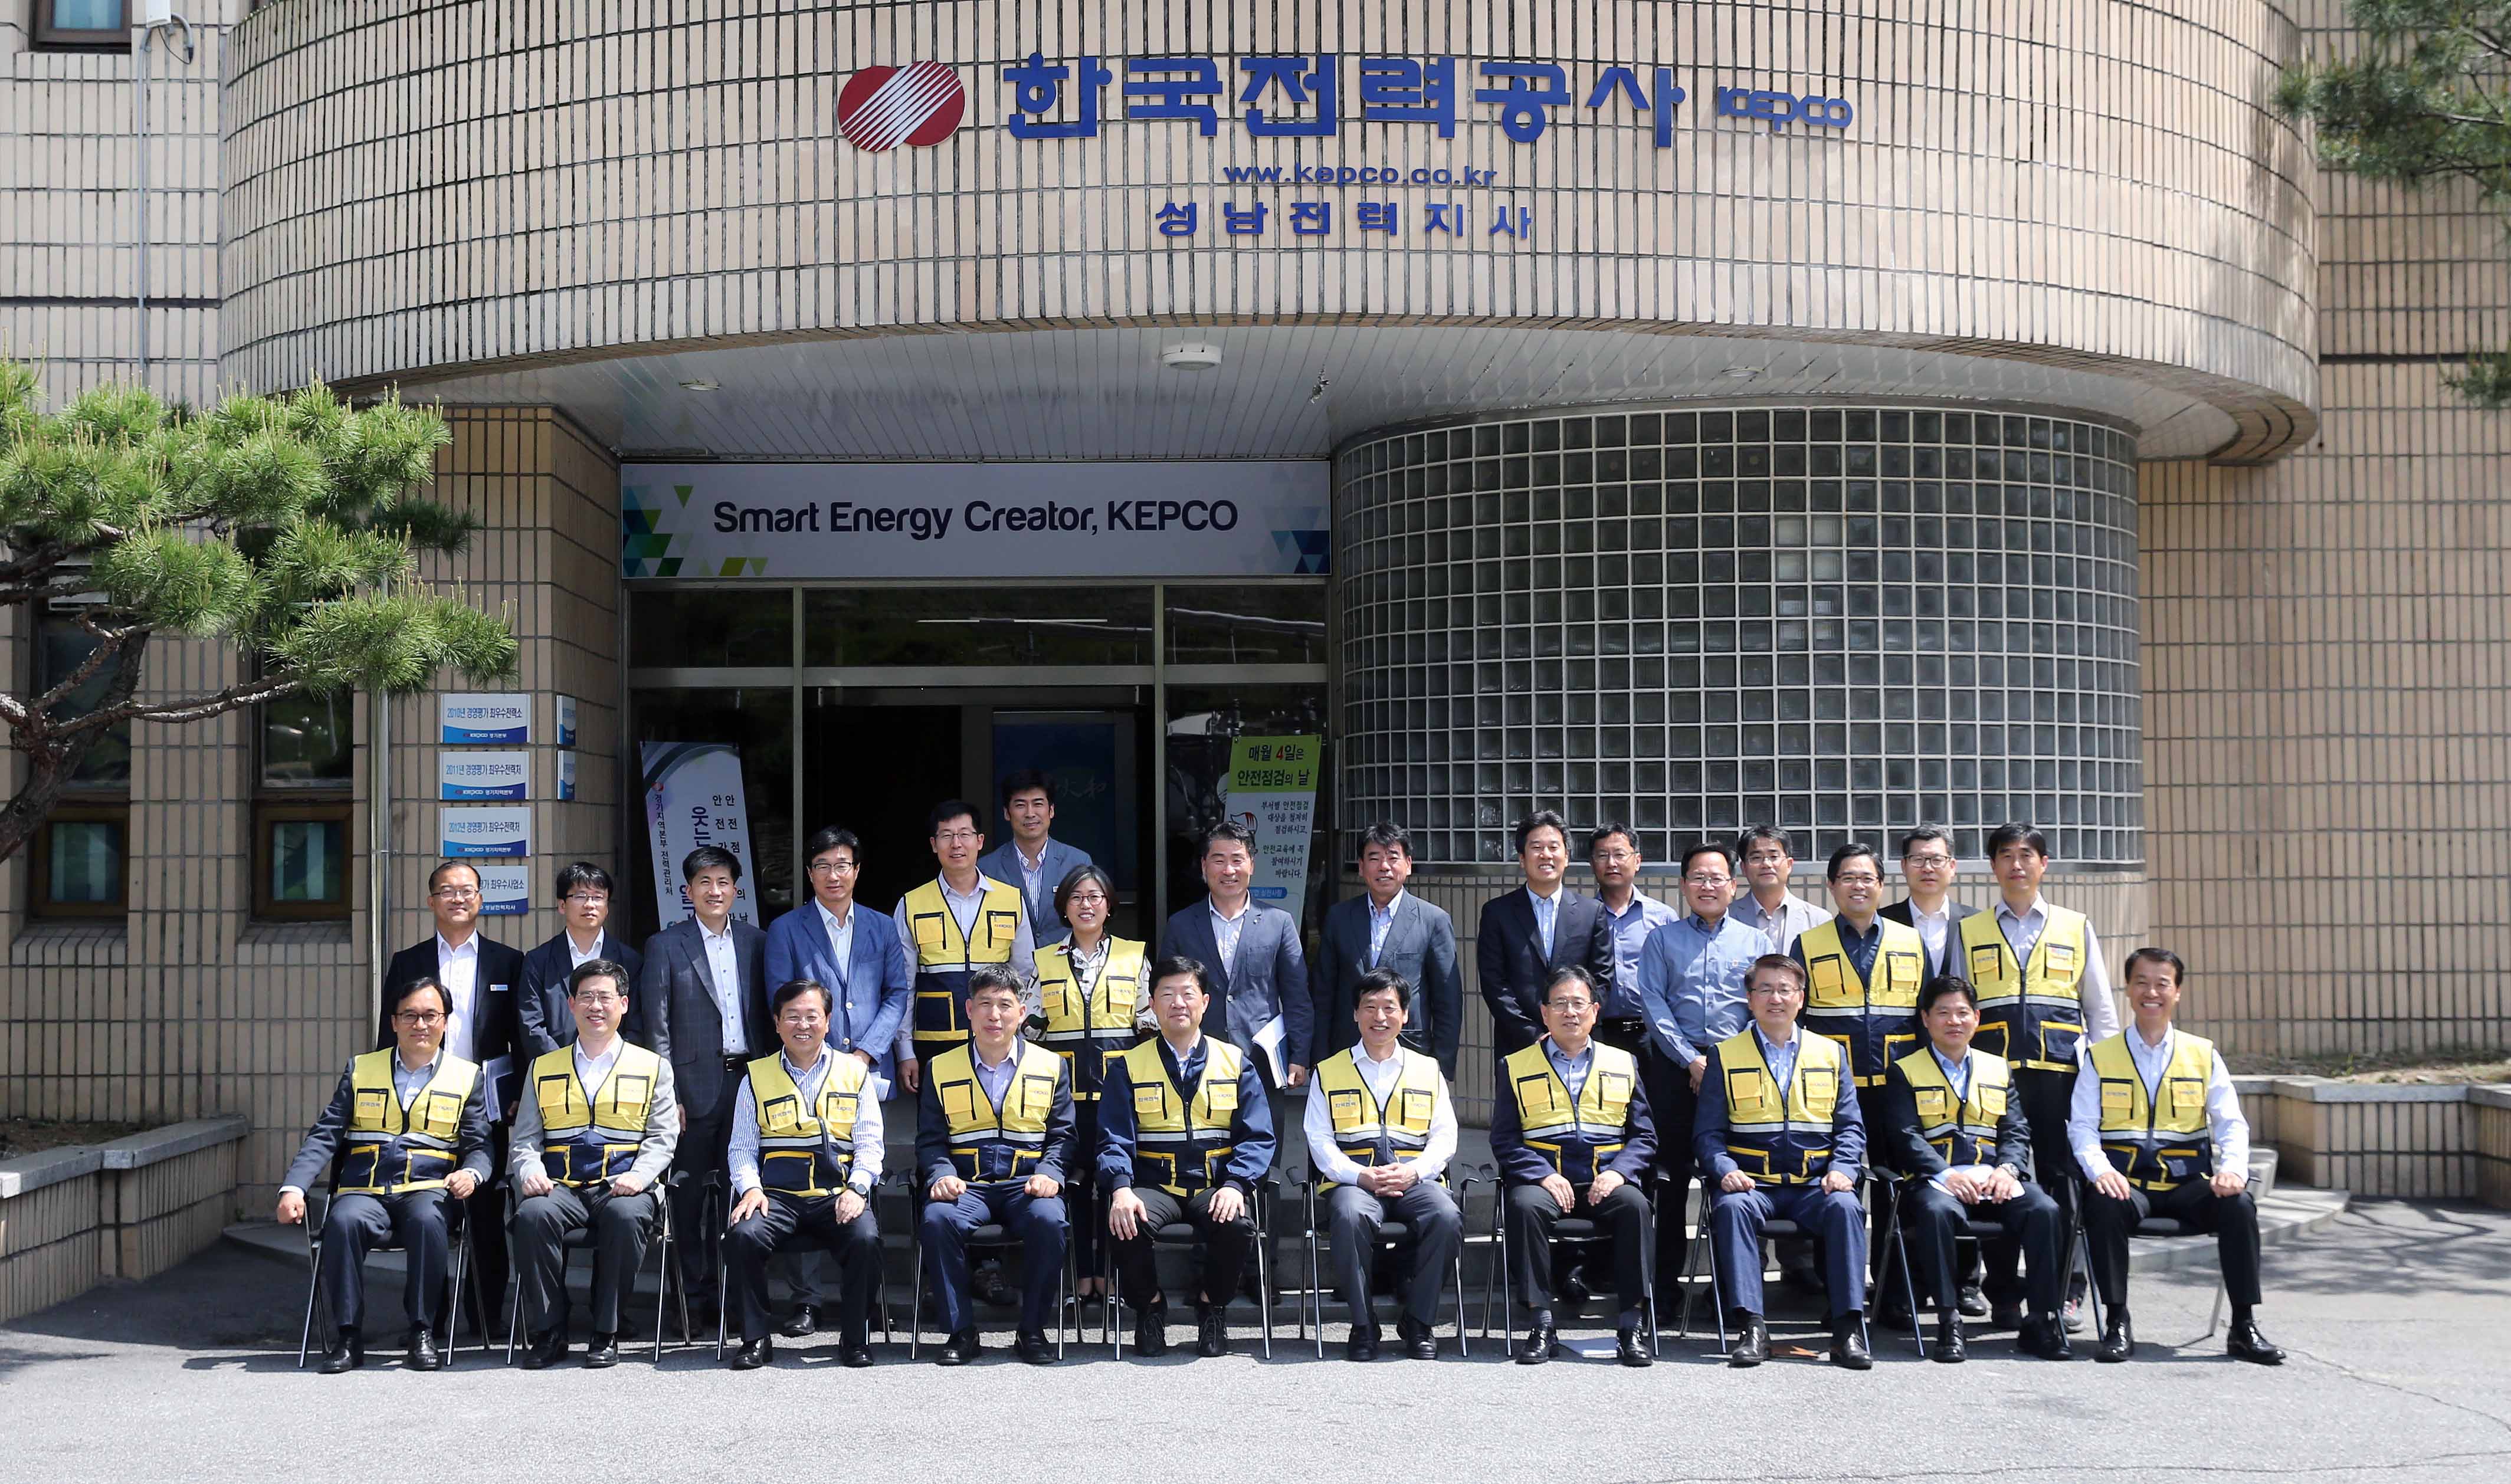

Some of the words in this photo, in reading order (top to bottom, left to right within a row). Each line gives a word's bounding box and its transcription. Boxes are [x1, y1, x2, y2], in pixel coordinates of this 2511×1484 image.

[1003, 52, 1686, 148] 한국전력공사
[1155, 202, 1532, 239] 성남전력지사
[713, 501, 820, 533] Smart
[830, 501, 953, 541] Energy
[964, 500, 1097, 536] Creator,
[1108, 500, 1238, 531] KEPCO
[1248, 745, 1272, 761] 매월
[1276, 744, 1304, 761] 4일은
[1237, 769, 1293, 787] 안전점검의
[1299, 769, 1310, 786] 날
